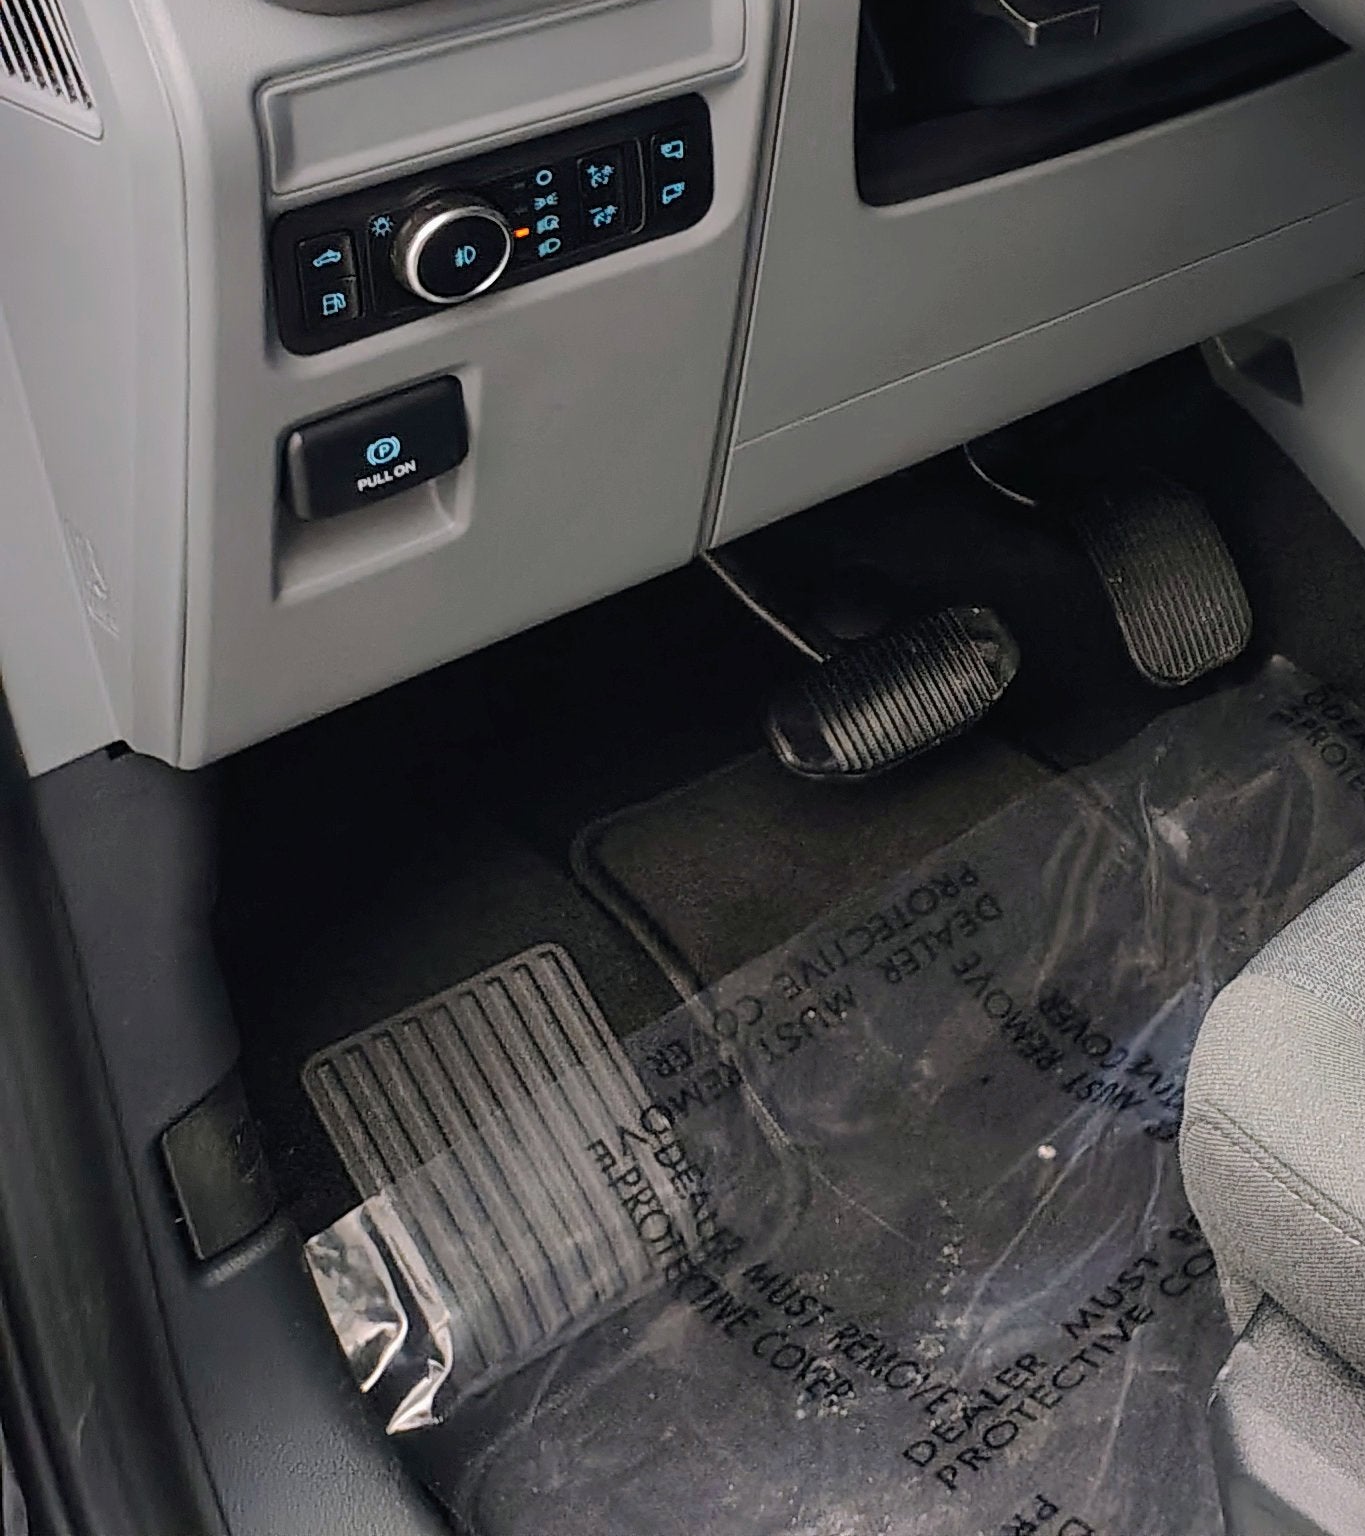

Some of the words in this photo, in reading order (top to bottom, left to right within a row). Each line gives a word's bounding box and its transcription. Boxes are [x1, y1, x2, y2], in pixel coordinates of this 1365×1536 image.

[357, 470, 394, 492] PULL
[393, 459, 417, 478] ON
[771, 861, 977, 1001] PROTECTIVE
[885, 893, 1001, 984] DEALER
[741, 1262, 835, 1328] MUST
[826, 1322, 963, 1417] REMOVE
[752, 1330, 856, 1409] COVER
[902, 1352, 1046, 1468] DEALER
[1061, 1255, 1159, 1340] MUST
[935, 1303, 1154, 1491] PROTECTIVE
